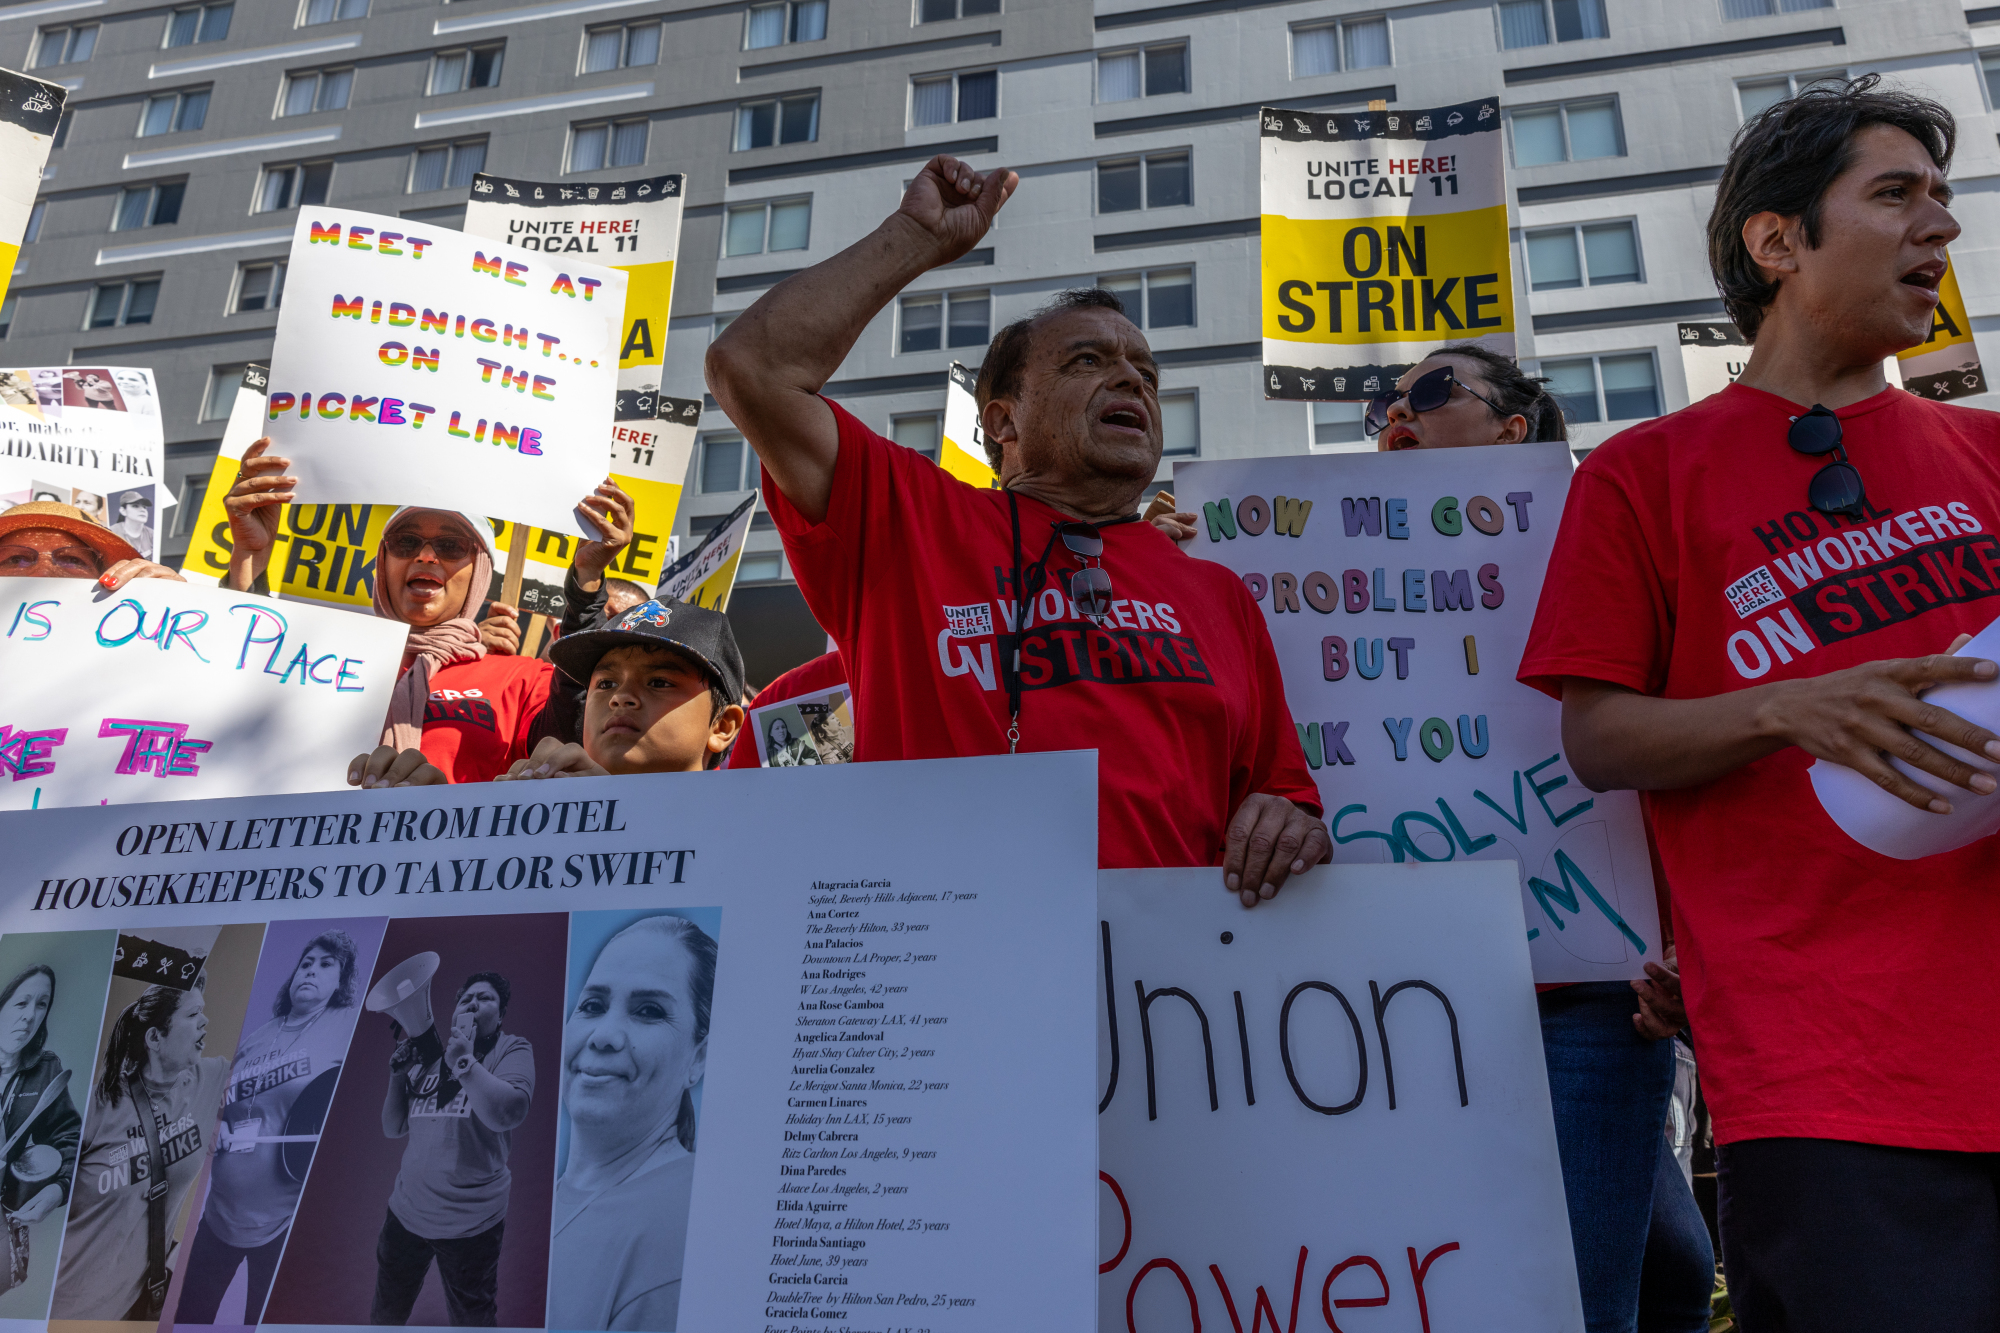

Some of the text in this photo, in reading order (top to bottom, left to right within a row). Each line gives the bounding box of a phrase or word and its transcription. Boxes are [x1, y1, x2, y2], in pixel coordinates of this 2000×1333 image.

[1307, 155, 1456, 177] UNITE HERE!
[1308, 174, 1458, 200] LOCAL 11
[510, 219, 640, 234] UNITE HERE!
[615, 235, 638, 252] 11
[1343, 225, 1427, 278] ON
[309, 221, 602, 302] MEET ME AT
[1278, 273, 1502, 333] STRIKE
[331, 294, 599, 368] MIDNIGHT...
[378, 341, 556, 401] ON THE
[269, 392, 543, 456] PICKET LINE
[0, 437, 102, 469] IDARITY
[112, 452, 154, 477] ERA
[632, 447, 654, 466] 11
[287, 504, 374, 547] ON
[1203, 491, 1533, 542] NOW WE GOT
[1752, 498, 1893, 555] HOTL
[702, 534, 732, 565] HERE!
[717, 544, 729, 562] 11
[1773, 502, 1982, 590] WORKERS
[203, 521, 378, 599] SRIK
[1243, 562, 1505, 613] PROBLEMS
[1726, 569, 1770, 599] UNITE
[1732, 579, 1775, 609] HERE!
[945, 605, 989, 618] UNITE
[997, 589, 1181, 633] WOKERS
[1738, 590, 1782, 615] LOCAL 11
[7, 599, 365, 692] IS OUR PLACE
[1726, 607, 1816, 680] ON
[937, 628, 1207, 691] ON STRIKE
[1322, 634, 1479, 682] BUT I
[97, 718, 213, 778] THE
[1383, 714, 1490, 763] YOU
[1331, 752, 1594, 863] SOLVE
[115, 799, 627, 857] OPEN LETTER FROM HOTEL
[30, 850, 696, 911] HOUSEKEEPERS TO TAYLOR SWIFT
[810, 879, 891, 892] Altagracia Garcia
[808, 891, 978, 906] Sofitel, Beverly Hills Adjacent, 17 years
[808, 909, 859, 919] Ana Cortez
[806, 922, 930, 935] The Beverly Hilton, 33 years
[804, 939, 863, 949] Ana Palacios
[802, 952, 937, 965] Downtown LA Proper, 2 years
[801, 969, 866, 981] Ana Rodriges
[800, 984, 908, 997] W Los Angeles, 42 years
[798, 1000, 884, 1010] Ana Rose Gamboa
[796, 1015, 948, 1028] Sheraton Gateway LAX, 41 years
[794, 1031, 884, 1044] Angelica Zandoval
[792, 1047, 935, 1060] Hyatt Shay Culver City, 2 years
[241, 1059, 309, 1098] STRIKE
[791, 1064, 875, 1074] Aurelia Gonzalez
[788, 1097, 867, 1107] Carmen Linares
[785, 1113, 912, 1127] Holiday Inn LAX, 15 years
[784, 1131, 858, 1144] Delmy Cabrera
[98, 1163, 128, 1194] ON
[780, 1165, 846, 1176] Dina Paredes
[778, 1183, 908, 1197] Alsace Los Angeles, 2 years
[776, 1200, 848, 1214] Elida Aguirre
[774, 1218, 801, 1229] Hotel
[802, 1218, 832, 1232] Maya,
[843, 1218, 874, 1230] Hilton
[876, 1219, 904, 1231] Hotel,
[907, 1219, 922, 1230] 25
[922, 1221, 950, 1234] years
[772, 1236, 866, 1250] Florinda Santiago
[770, 1254, 868, 1269] Hotel June, 39 years
[769, 1273, 848, 1285] Graciela Garcia
[766, 1306, 847, 1319] Graciela Gomez
